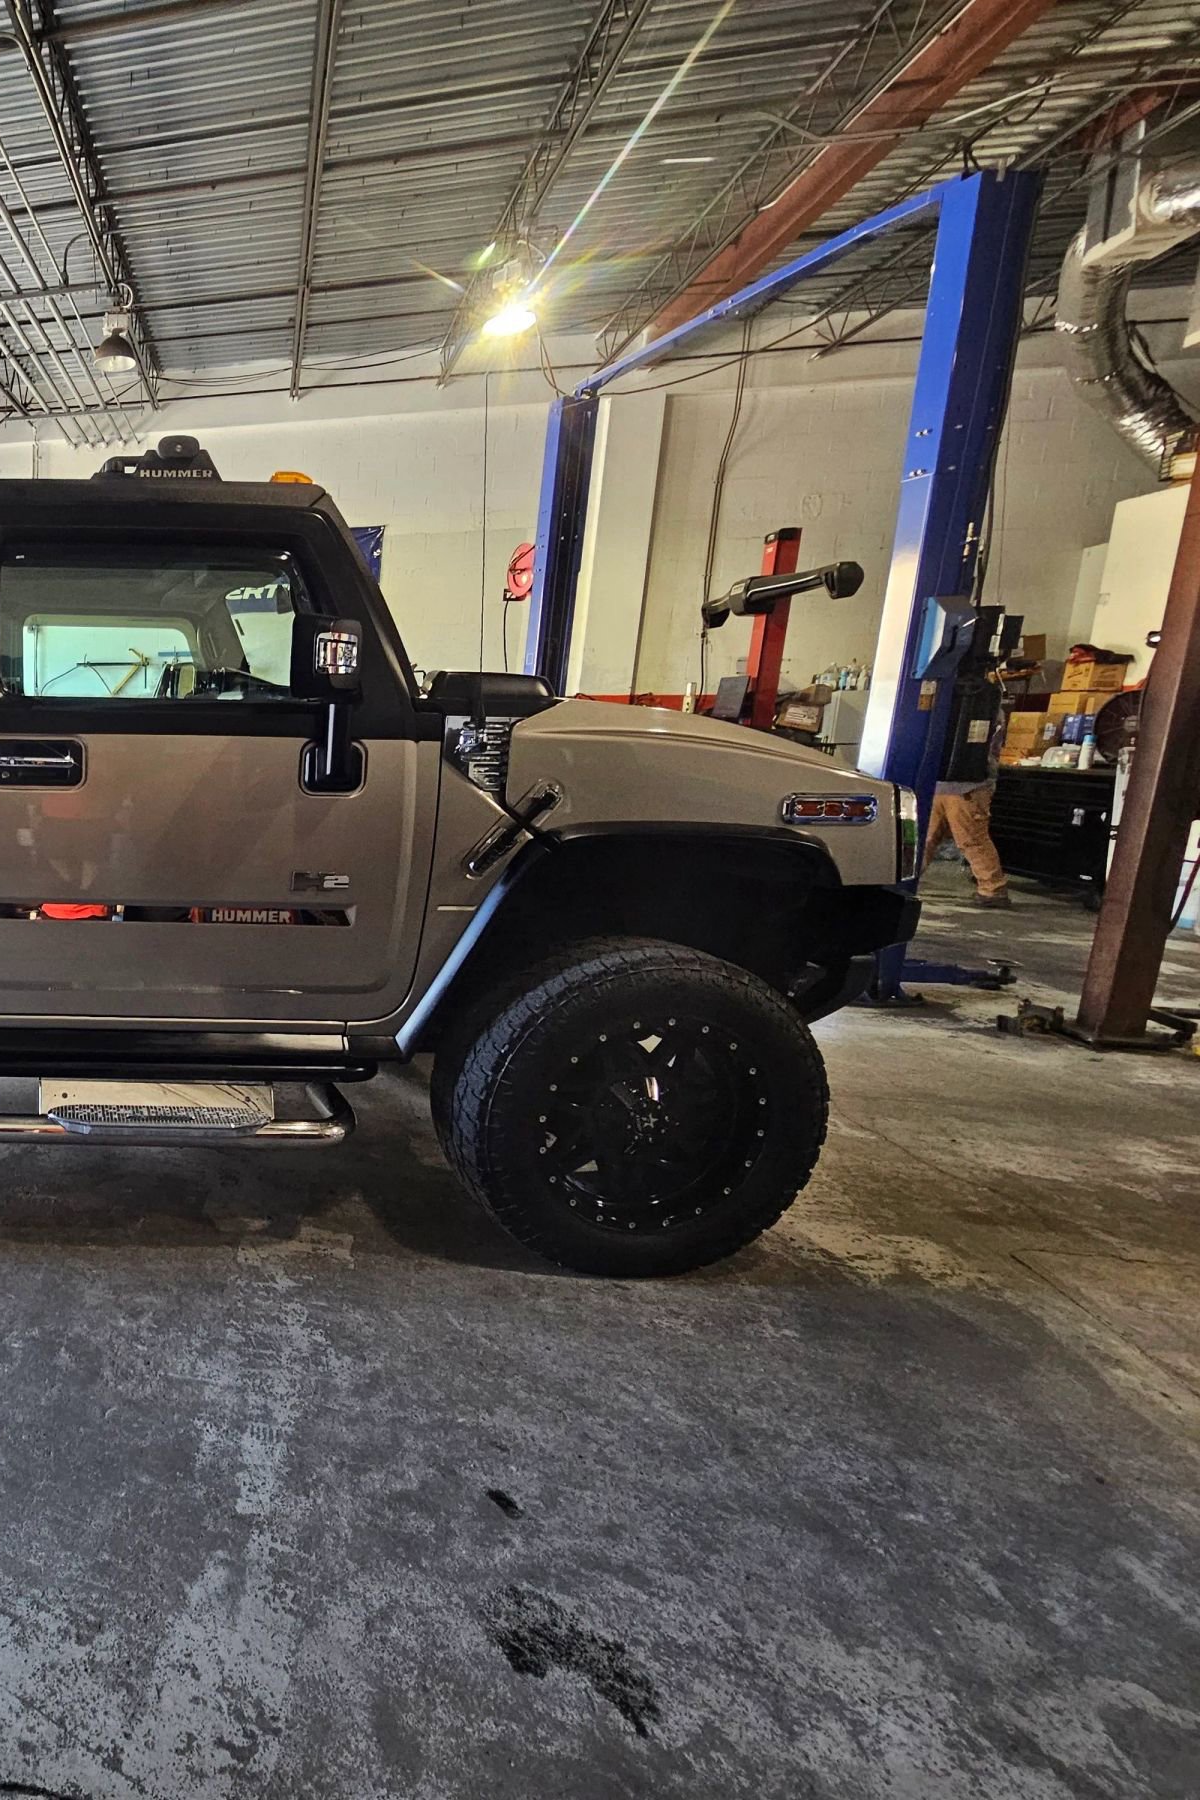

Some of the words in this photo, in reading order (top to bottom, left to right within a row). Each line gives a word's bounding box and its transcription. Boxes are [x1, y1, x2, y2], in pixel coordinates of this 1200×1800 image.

[140, 469, 213, 478] HUMMER
[290, 871, 350, 891] H2
[211, 909, 292, 924] HUMMER
